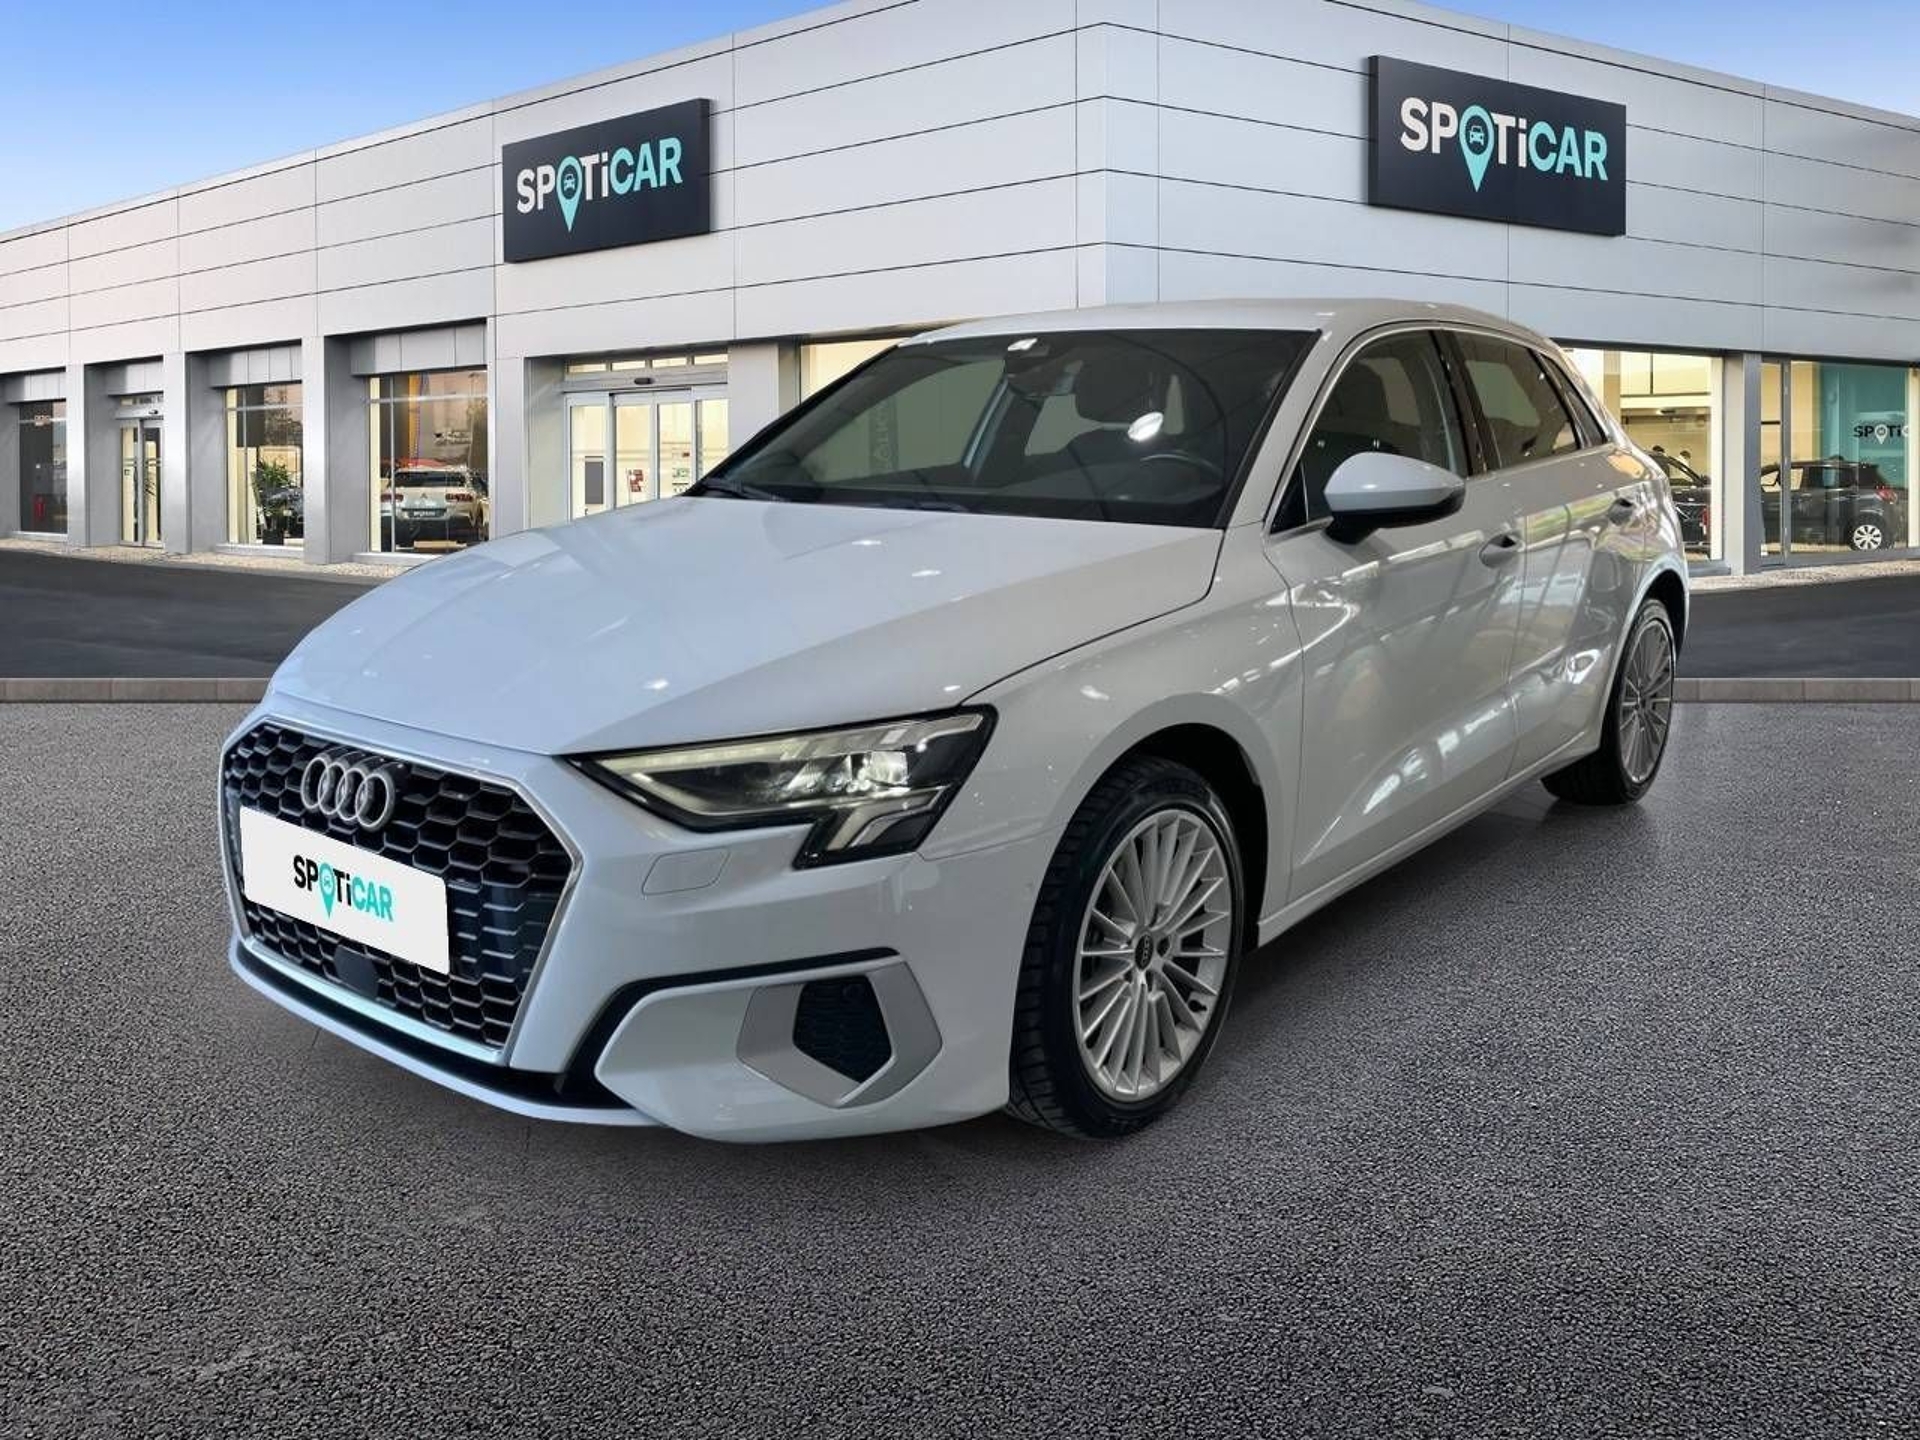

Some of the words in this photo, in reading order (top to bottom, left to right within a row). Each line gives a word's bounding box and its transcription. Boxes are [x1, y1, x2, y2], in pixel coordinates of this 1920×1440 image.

[516, 137, 683, 232] SPOTiCAR
[1400, 97, 1609, 193] SPOTiCAR
[293, 854, 394, 922] SPOTiCAR
